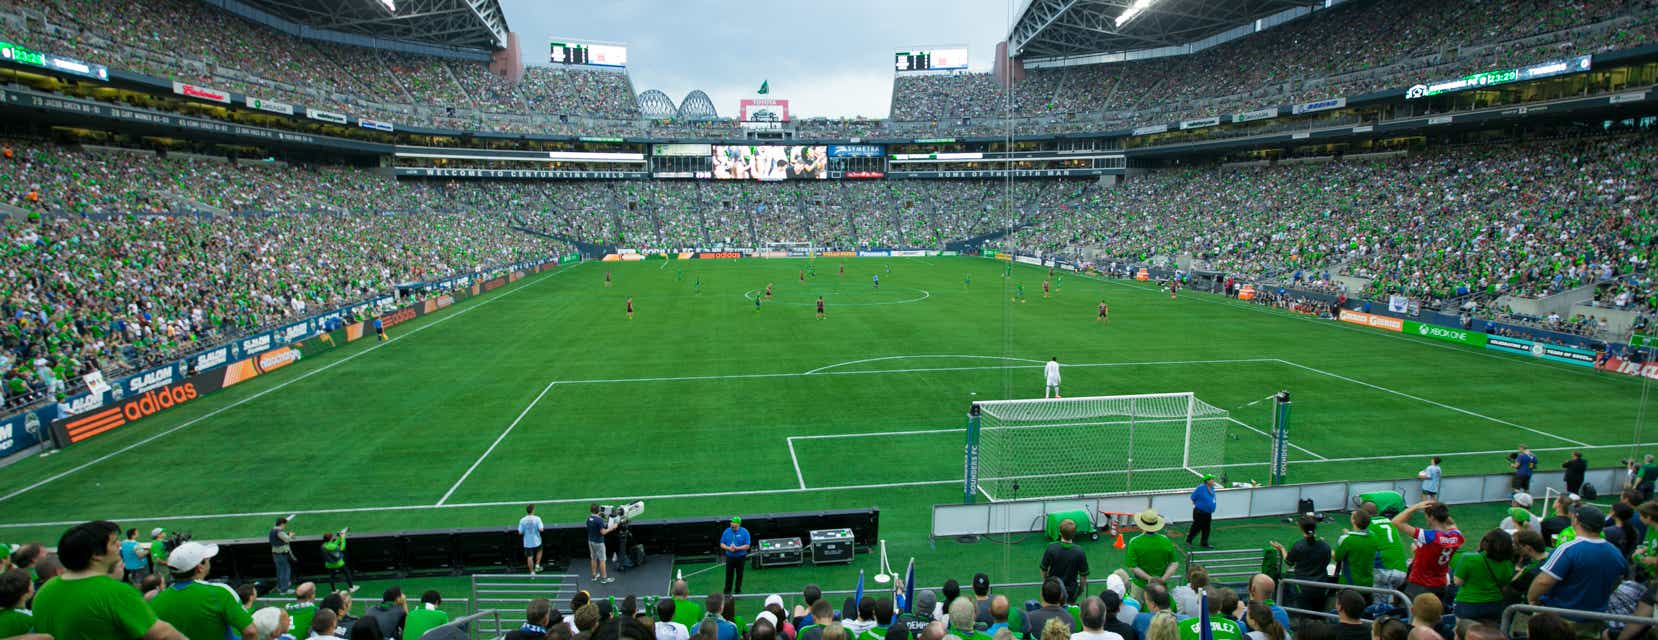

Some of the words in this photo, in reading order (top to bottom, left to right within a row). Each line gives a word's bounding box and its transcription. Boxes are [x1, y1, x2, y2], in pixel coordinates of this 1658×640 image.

[426, 168, 483, 176] WELCOME
[490, 169, 503, 177] TO
[512, 170, 588, 178] CENTURYLINK
[1429, 328, 1450, 337] XBOX
[1450, 331, 1467, 340] ONE
[129, 366, 173, 391] SLALOM
[123, 382, 197, 421] adidas
[906, 621, 930, 630] DEMP
